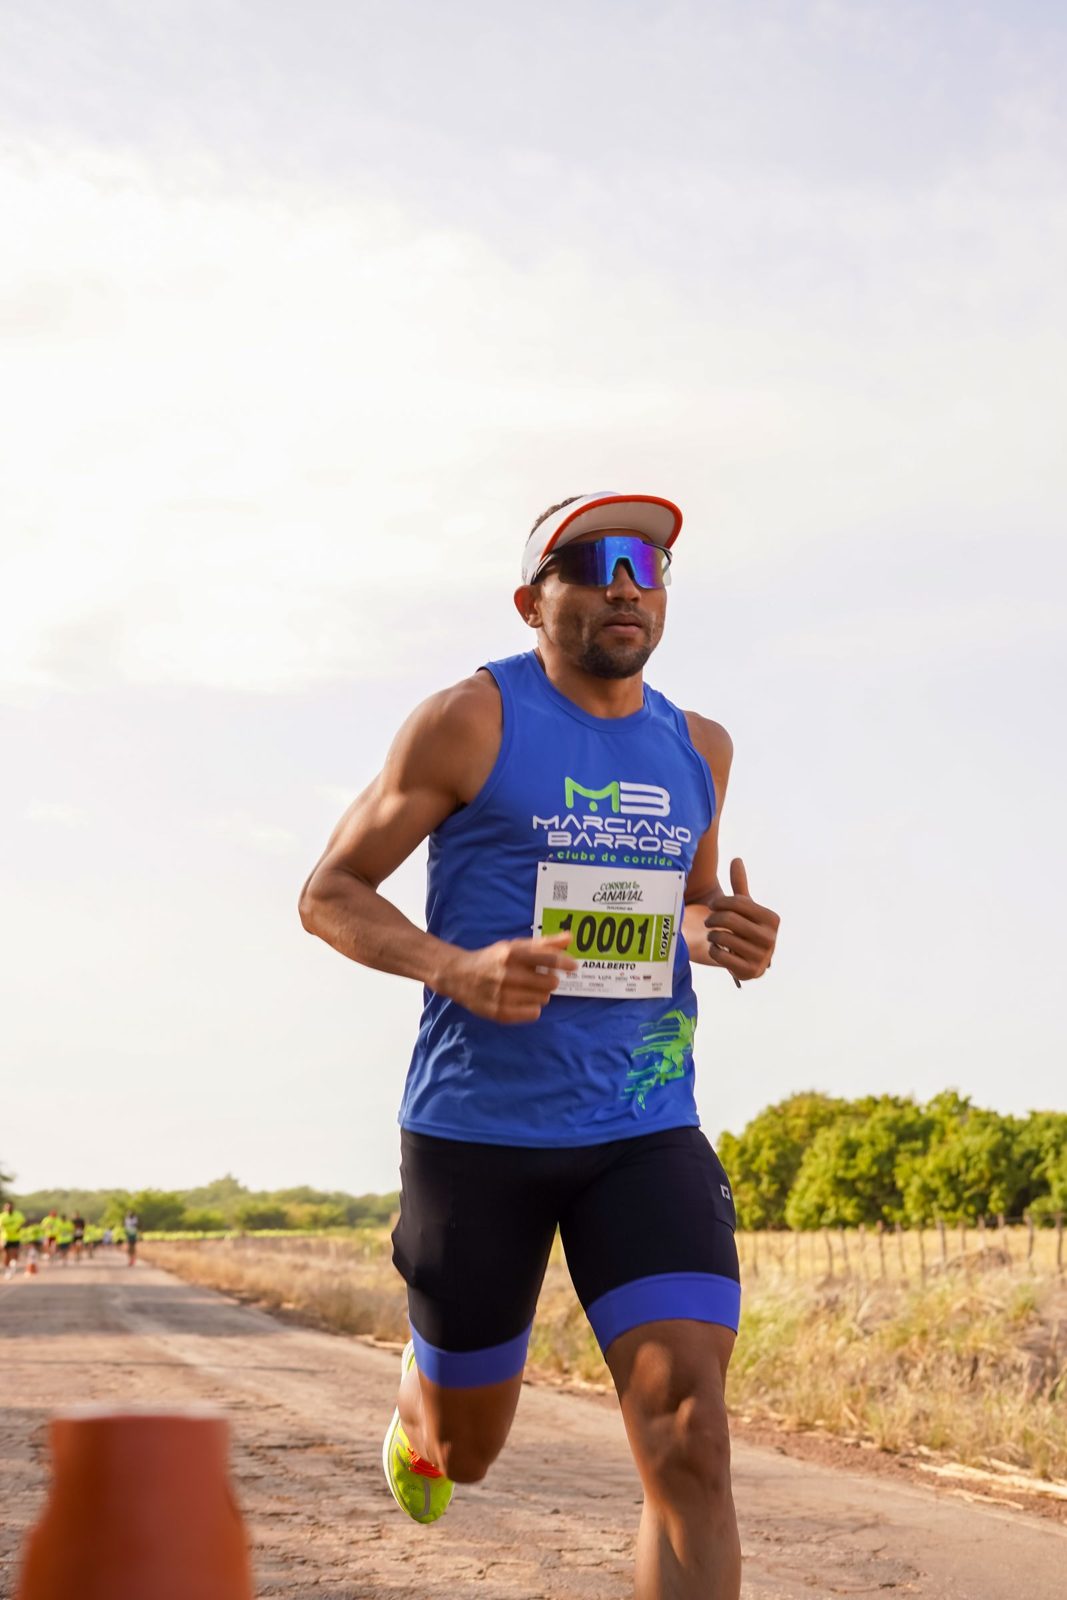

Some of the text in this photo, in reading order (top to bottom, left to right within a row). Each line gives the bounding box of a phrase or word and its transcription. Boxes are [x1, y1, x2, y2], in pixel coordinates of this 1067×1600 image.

[565, 776, 670, 817] MB
[532, 814, 691, 843] MARCIANO
[547, 831, 682, 856] BARROS
[557, 851, 673, 867] clube de corrida
[592, 890, 644, 903] CANAVIAL
[659, 916, 671, 958] 10KM
[582, 961, 636, 970] ADALBERTO
